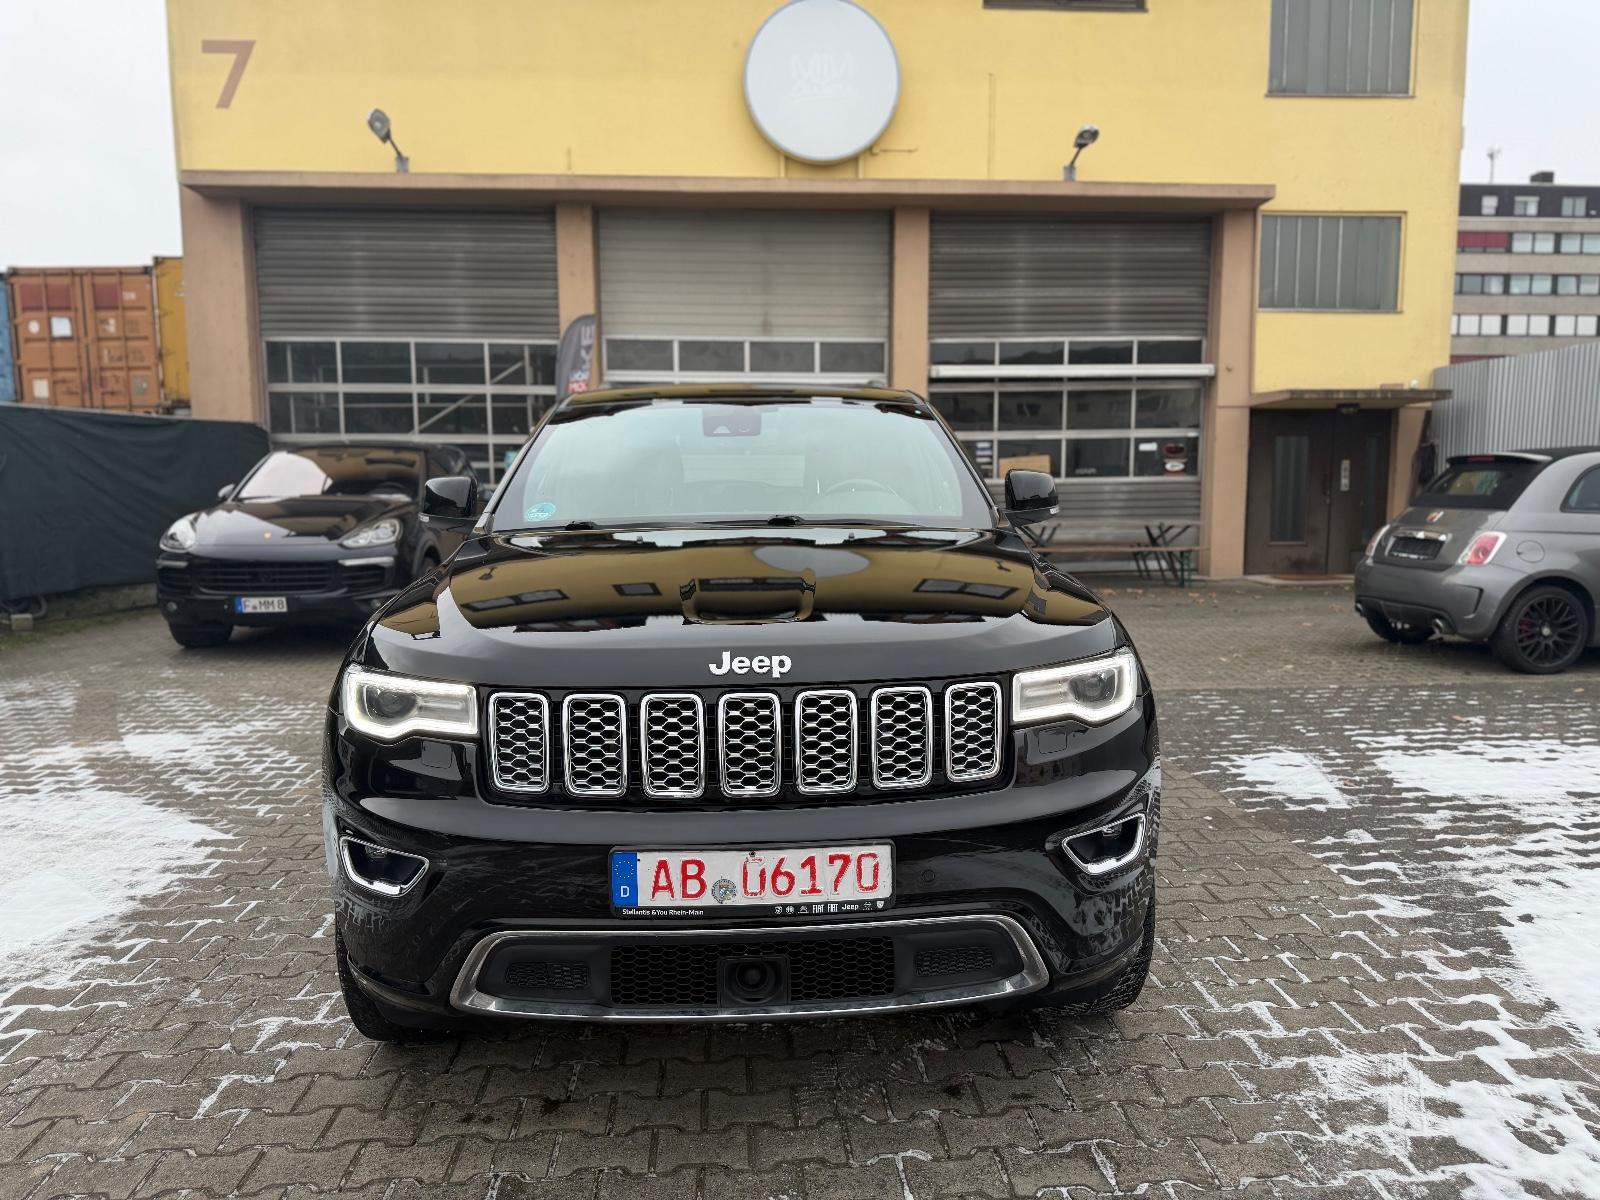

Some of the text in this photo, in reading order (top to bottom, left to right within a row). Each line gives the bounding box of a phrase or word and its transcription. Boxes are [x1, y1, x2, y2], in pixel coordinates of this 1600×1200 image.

[201, 39, 256, 109] 7
[277, 600, 285, 609] 8
[708, 651, 792, 678] Jeep
[651, 852, 879, 900] AB 06170
[620, 886, 630, 898] D
[812, 904, 825, 914] FIAT
[827, 903, 838, 912] FIAT
[841, 903, 859, 911] Jeep
